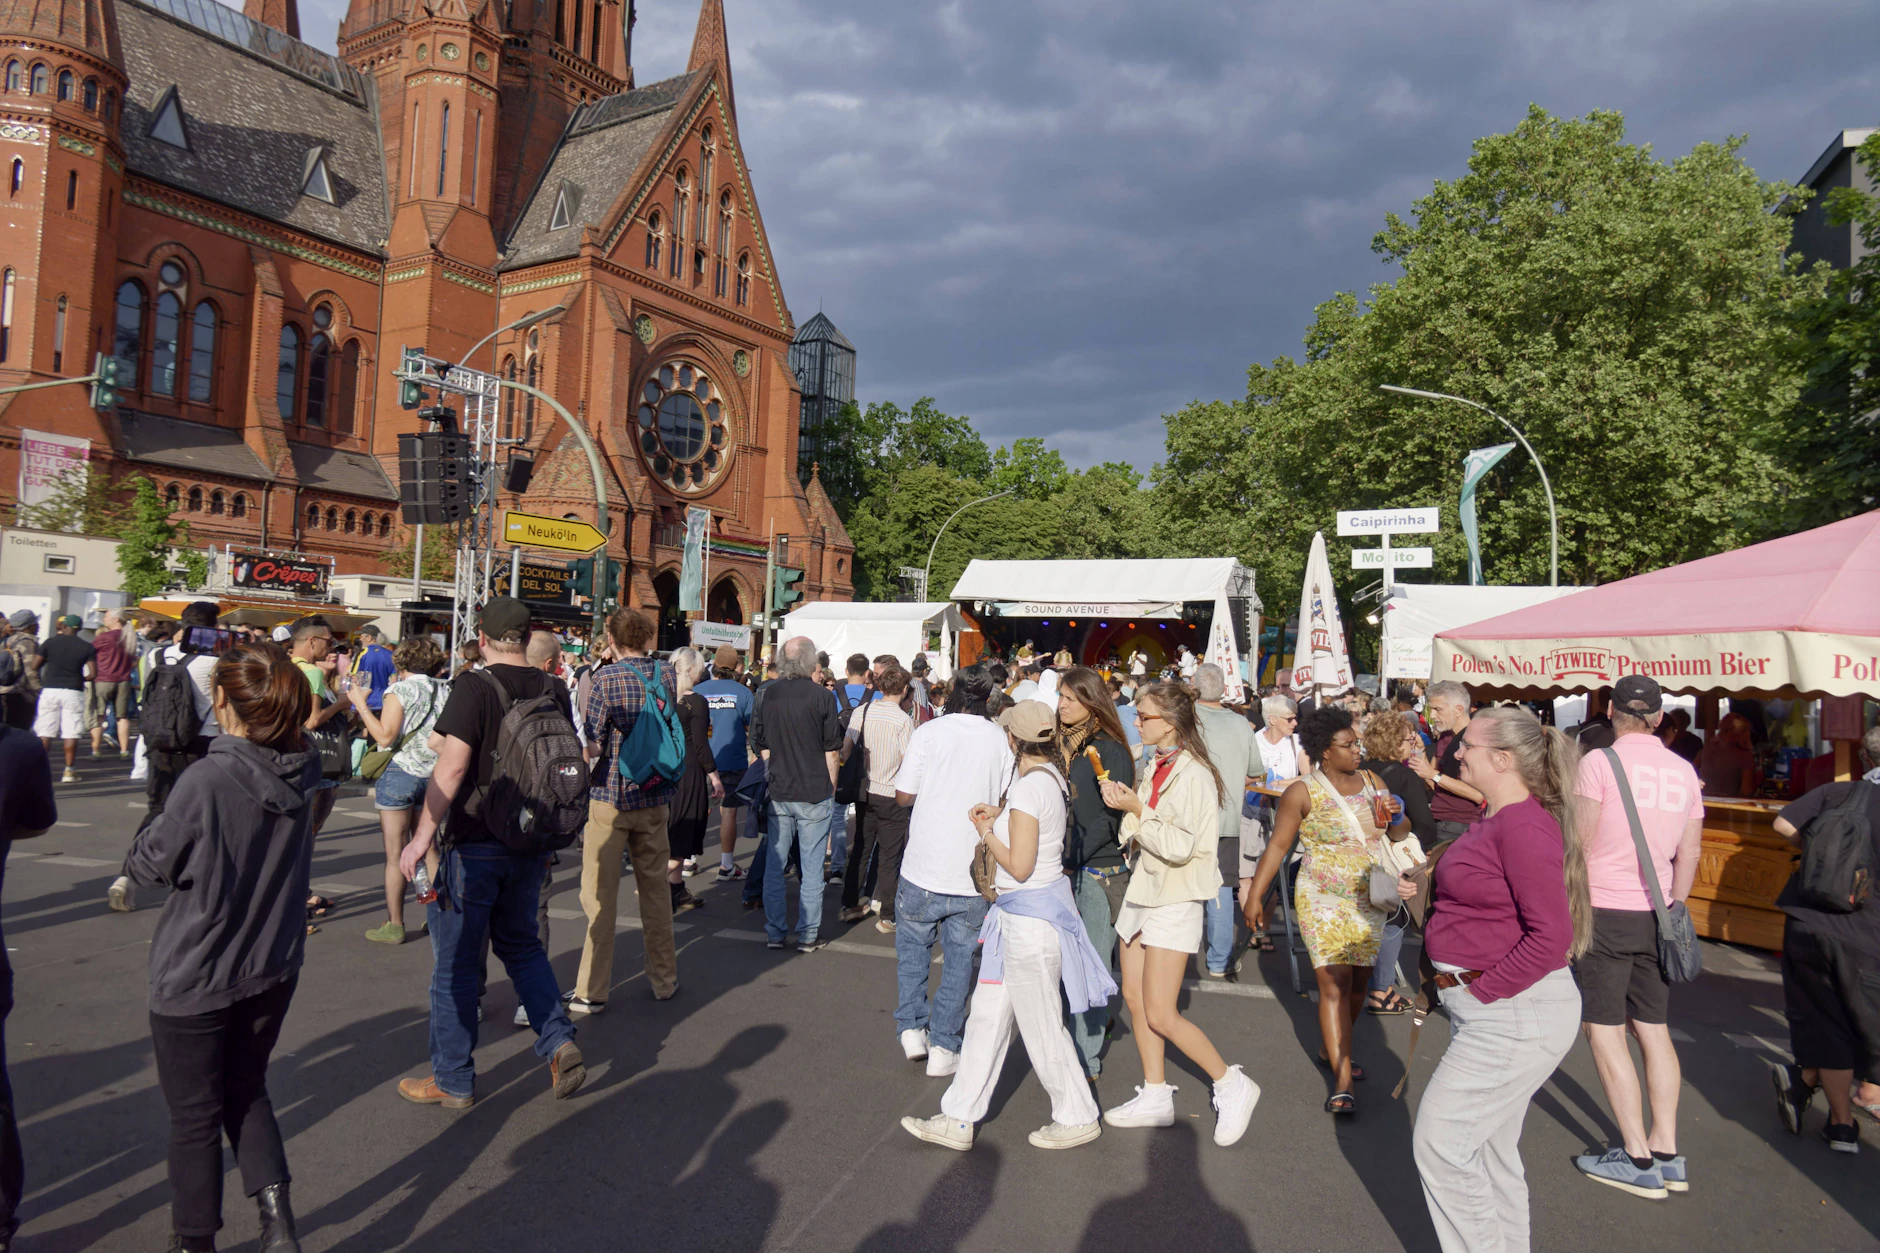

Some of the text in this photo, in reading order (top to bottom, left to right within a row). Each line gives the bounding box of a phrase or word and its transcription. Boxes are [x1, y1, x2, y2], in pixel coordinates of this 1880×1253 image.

[27, 440, 66, 457] LIEBE
[26, 452, 51, 466] TUT
[25, 476, 53, 488] GUT
[1350, 515, 1426, 528] Caipirinha
[527, 524, 577, 541] Neukölln
[9, 535, 58, 548] Toiletten
[1361, 551, 1415, 562] Moito
[252, 561, 317, 584] Crêpes
[519, 566, 570, 580] COCKTAILS
[522, 579, 563, 592] DEL SOL
[1024, 606, 1062, 614] SOUND
[1066, 606, 1110, 614] AVENUE
[1452, 654, 1506, 674] Polen's
[1555, 651, 1606, 670] ŻYWIEC
[1616, 654, 1712, 676] Premium
[1720, 652, 1770, 676] Bier
[1831, 654, 1880, 681] Pol
[708, 702, 734, 710] tagonia
[560, 766, 578, 776] FILA
[1631, 763, 1687, 812] 66
